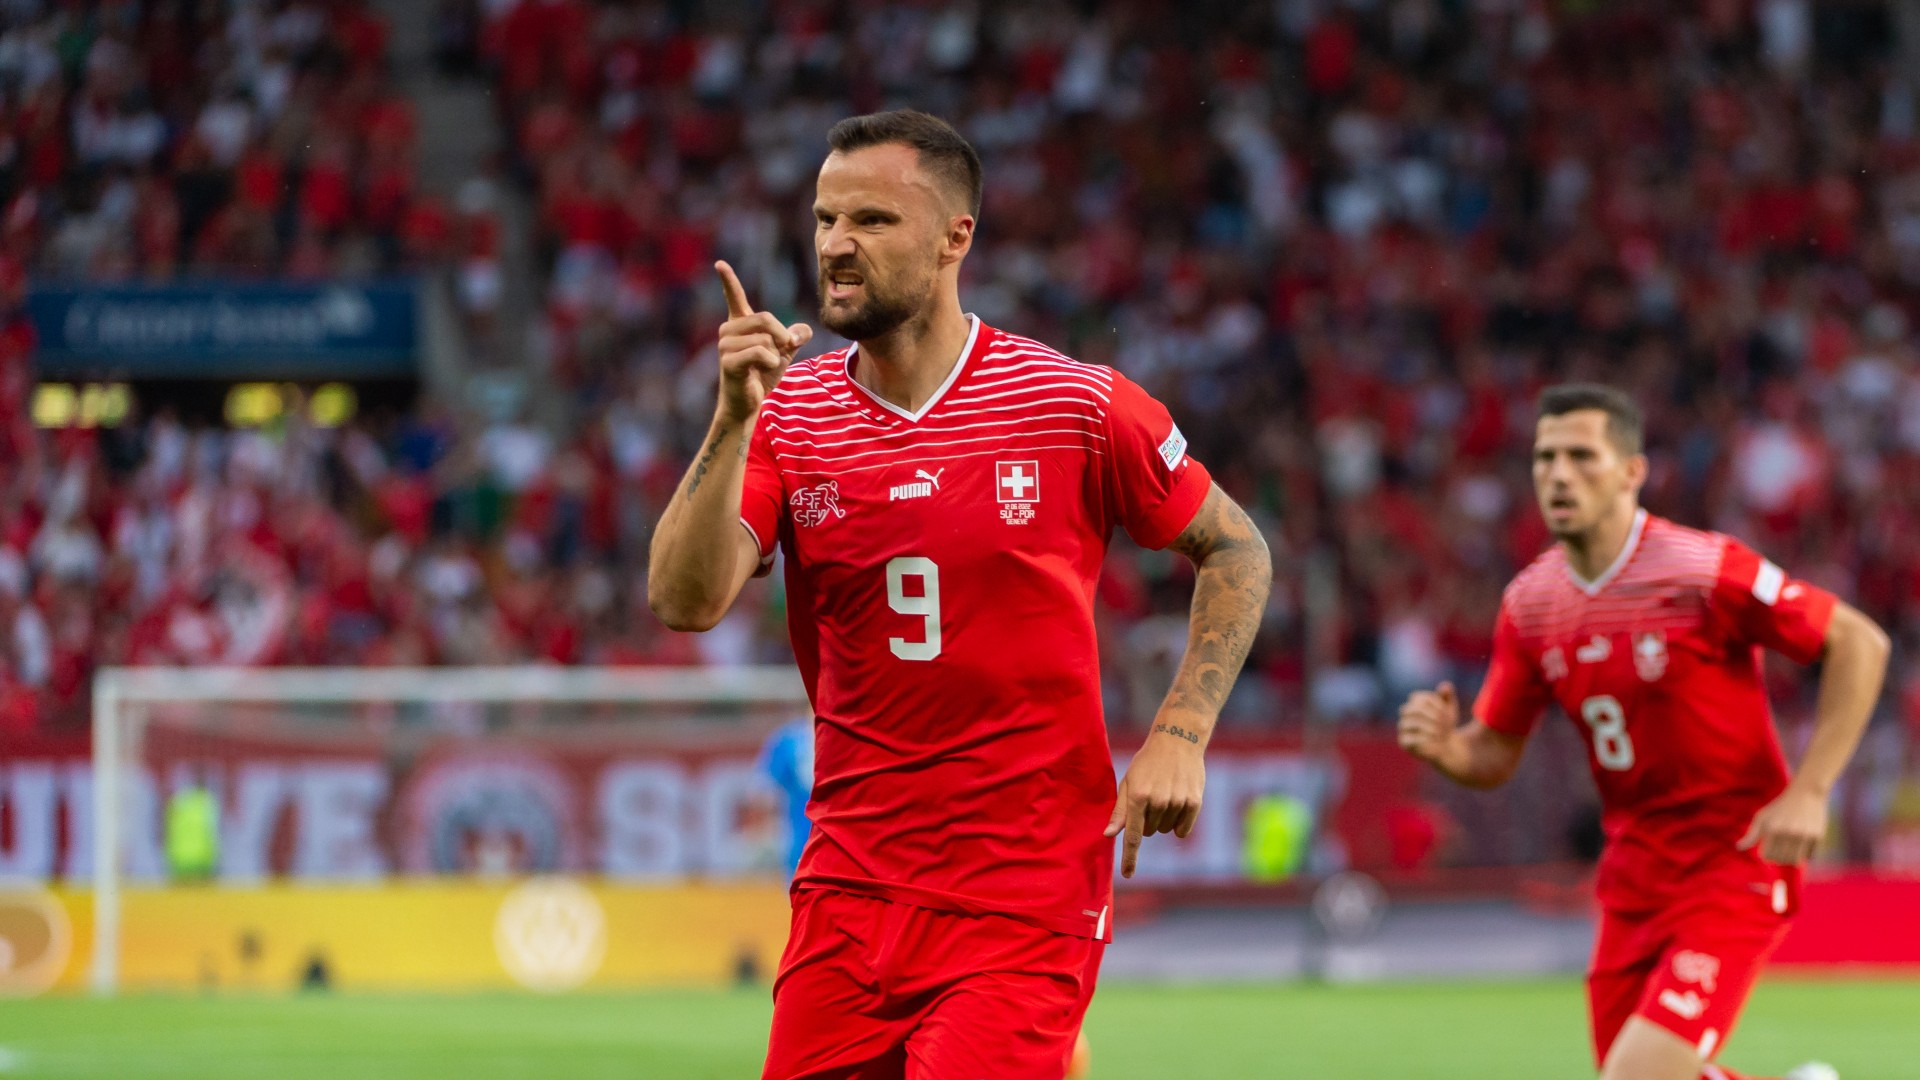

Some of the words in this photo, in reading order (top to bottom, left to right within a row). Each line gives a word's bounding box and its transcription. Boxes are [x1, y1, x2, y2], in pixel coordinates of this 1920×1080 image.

[890, 482, 931, 501] PUMA
[1000, 510, 1013, 519] SUI
[1019, 510, 1035, 519] POR
[886, 556, 942, 661] 9
[1581, 694, 1635, 771] 8
